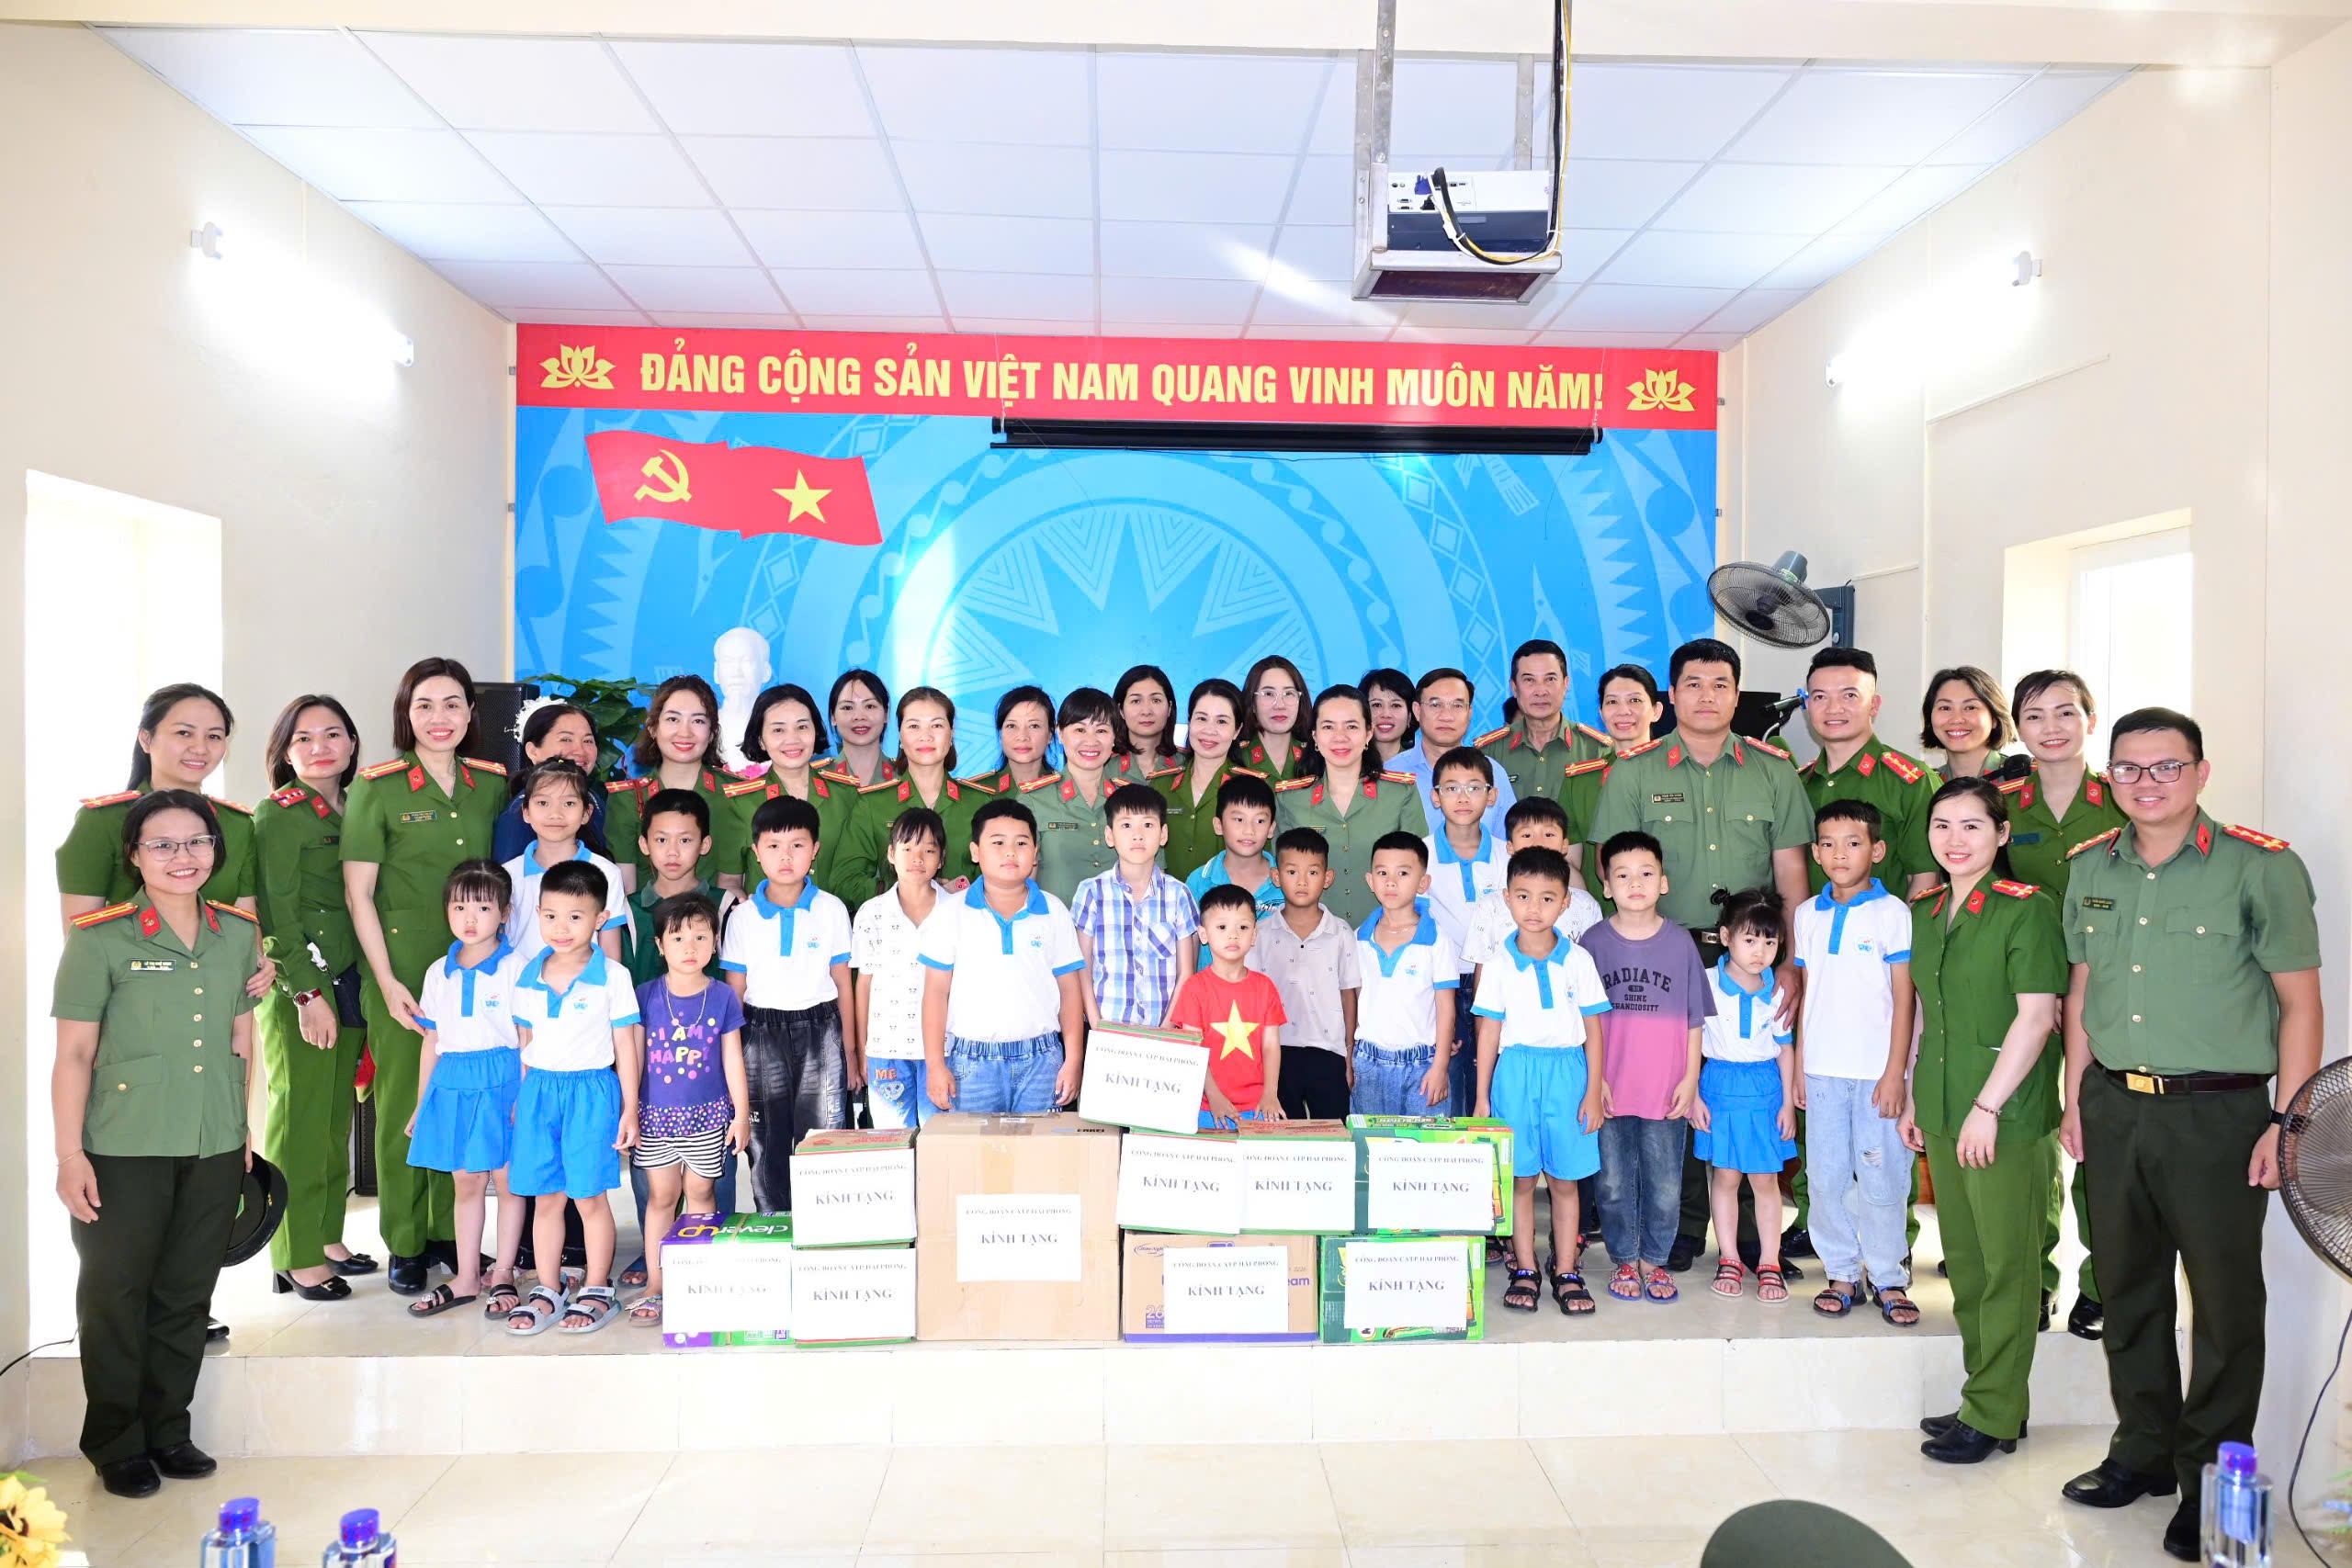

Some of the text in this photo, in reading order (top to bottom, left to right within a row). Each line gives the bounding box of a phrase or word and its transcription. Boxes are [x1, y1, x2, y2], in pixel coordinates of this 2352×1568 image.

[640, 338, 1604, 410] ĐẢNG CỘNG SẢN VIỆT NAM QUANG VINH MUÔN NĂM!
[1602, 967, 1671, 993] RADIATE
[1624, 994, 1647, 1002] SHINE
[659, 1024, 704, 1041] I AM
[650, 1046, 710, 1066] HAPPY
[875, 1069, 898, 1080] ME
